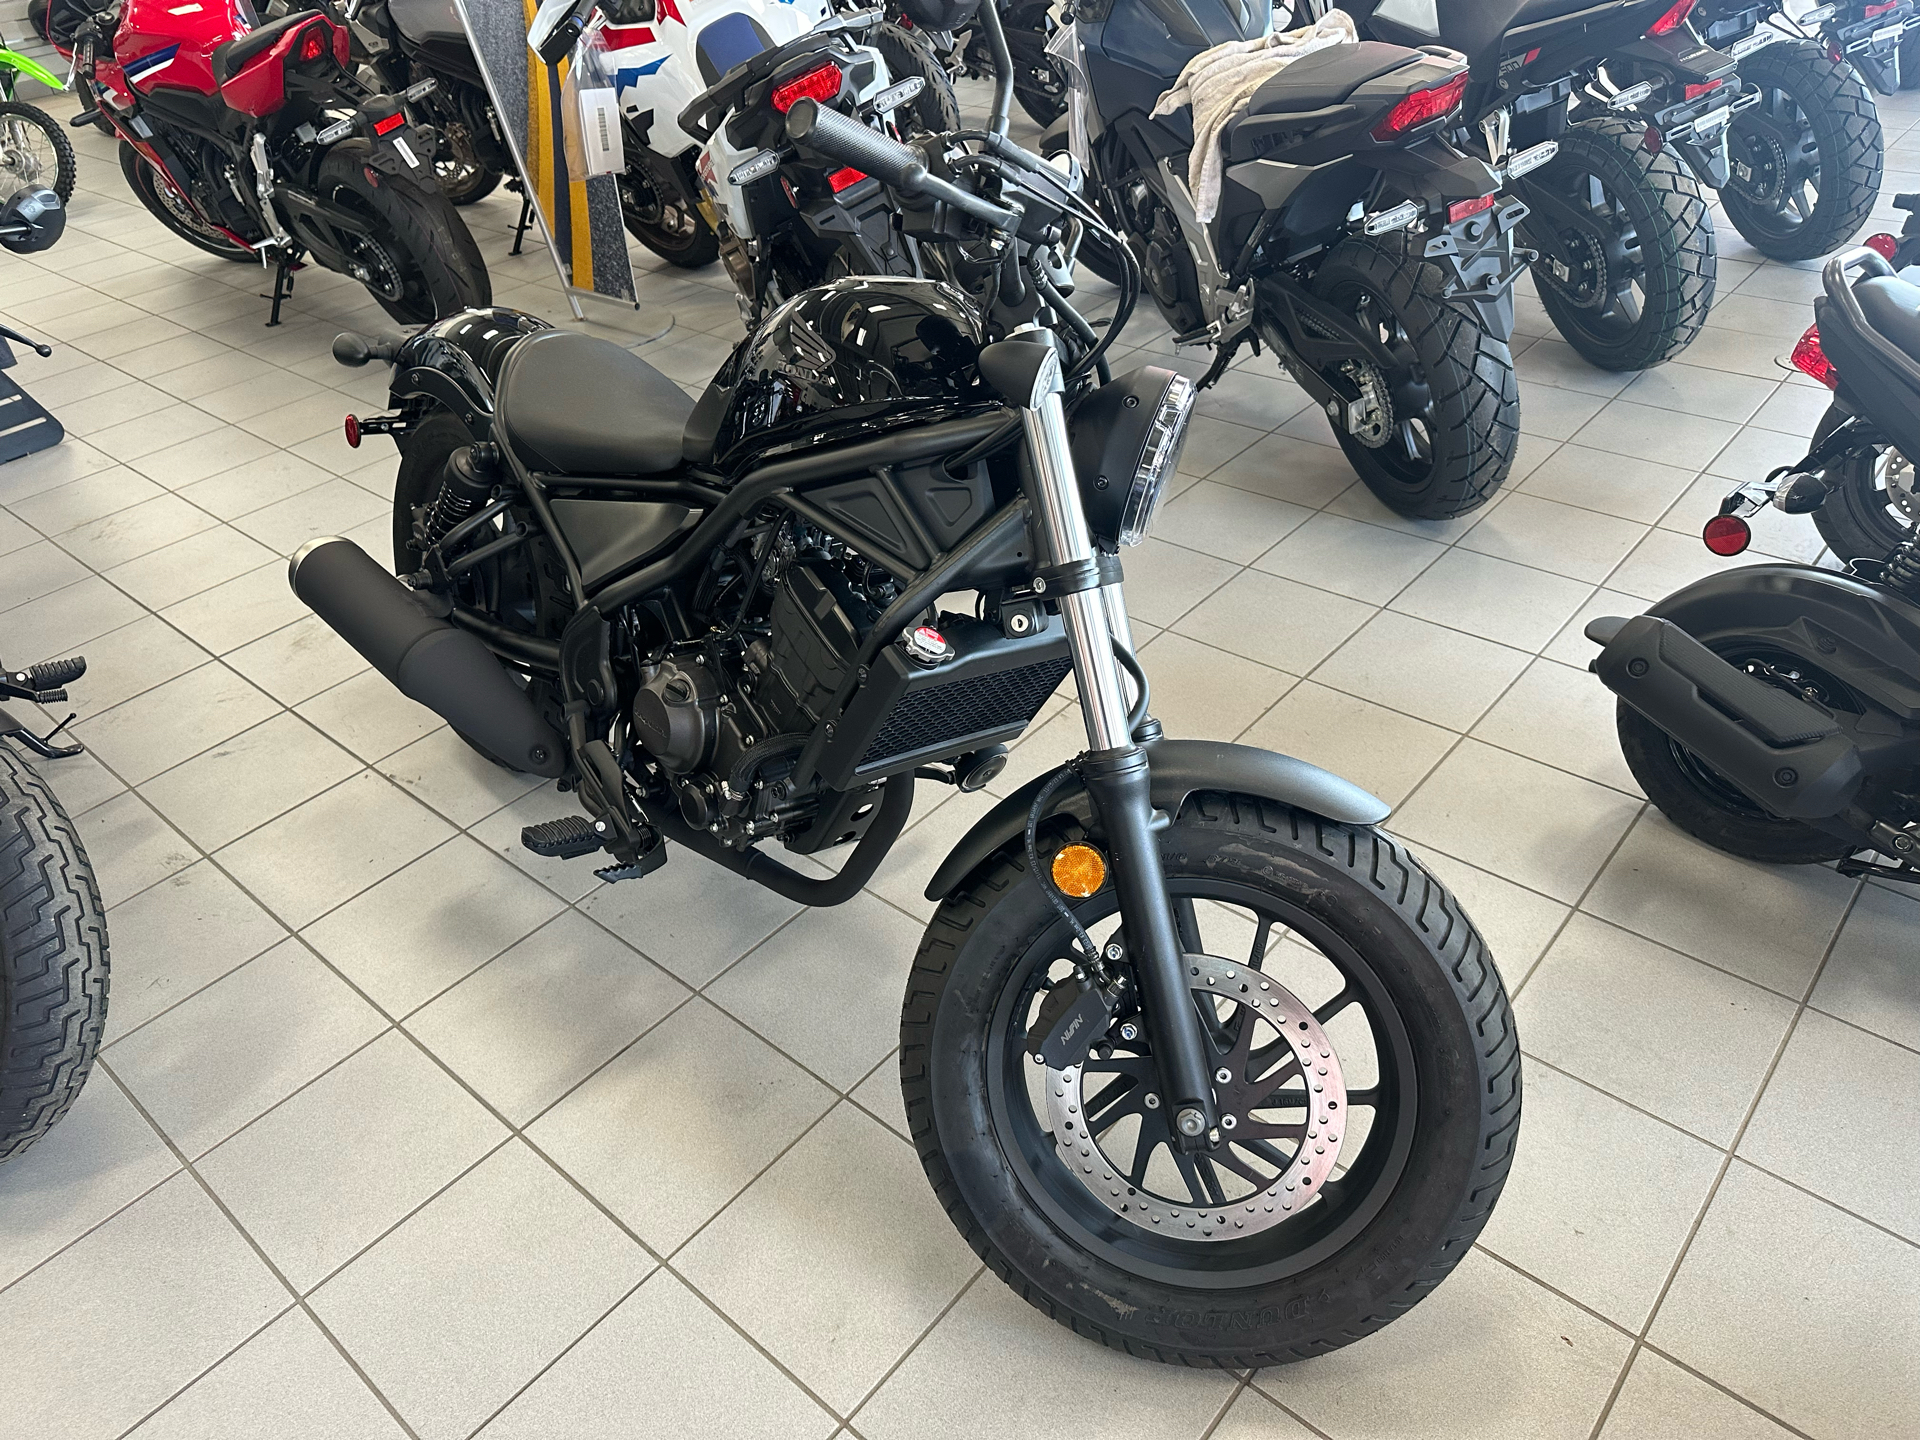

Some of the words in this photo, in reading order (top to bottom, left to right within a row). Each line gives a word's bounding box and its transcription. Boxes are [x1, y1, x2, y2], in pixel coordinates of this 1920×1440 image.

[777, 361, 833, 387] HONDA
[1061, 1013, 1083, 1046] NISSIN
[1144, 1295, 1310, 1332] DUNLOP
